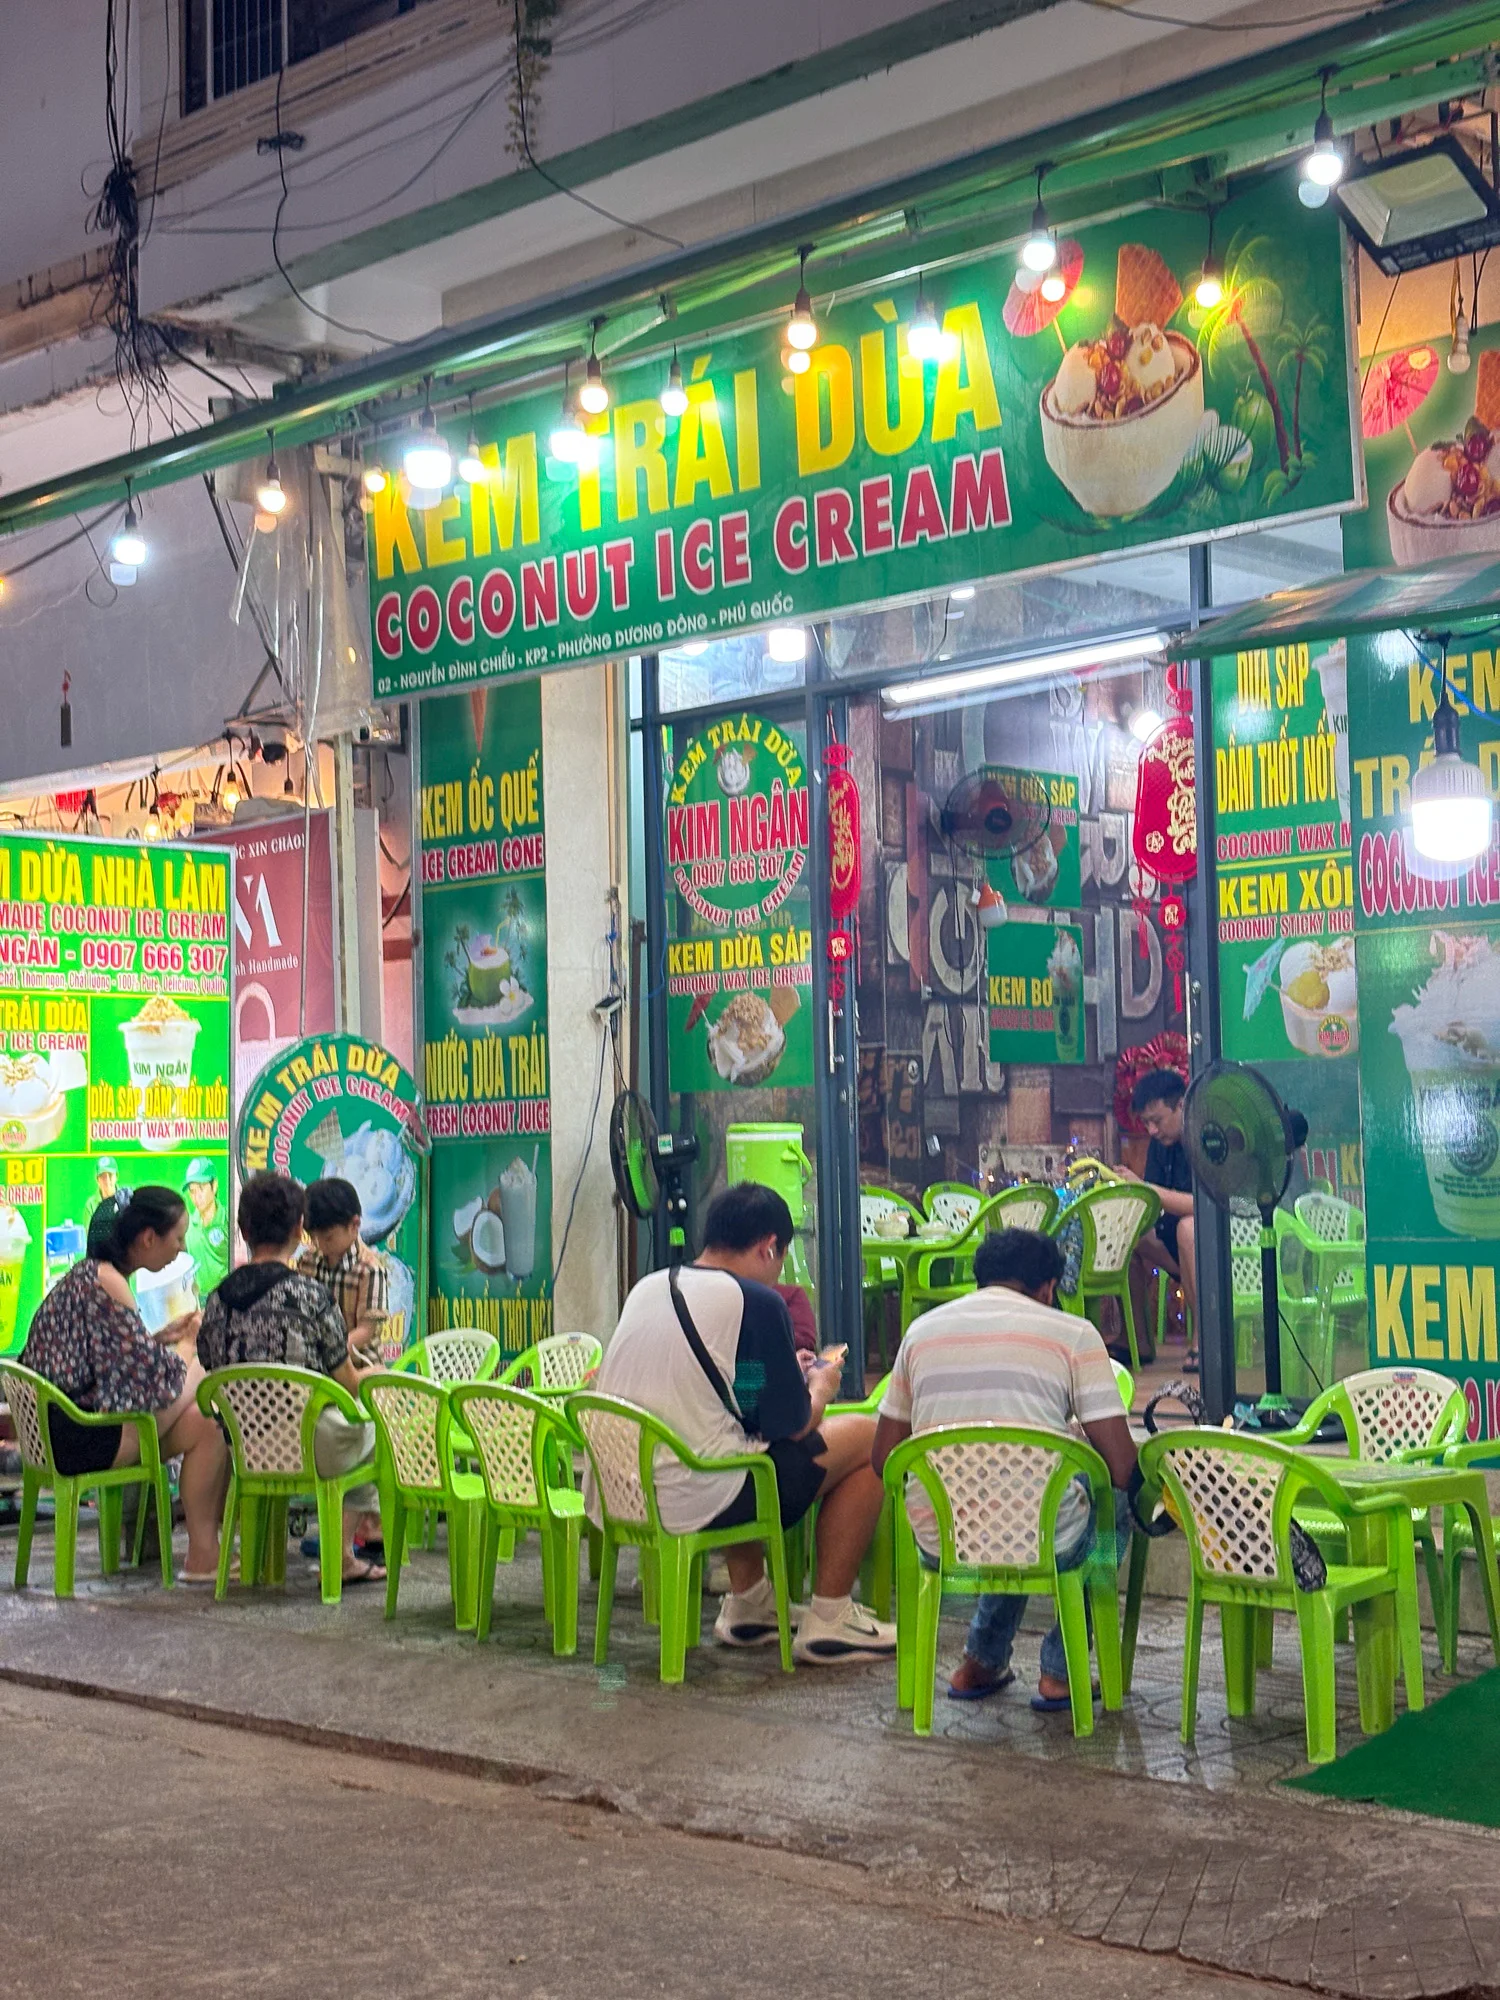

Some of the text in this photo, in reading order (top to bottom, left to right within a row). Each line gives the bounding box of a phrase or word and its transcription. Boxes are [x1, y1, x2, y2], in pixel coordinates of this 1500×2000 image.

[373, 431, 541, 582] KEM
[576, 355, 762, 532] TRÁI
[374, 446, 1014, 662] COCONUT ICE CREAM
[377, 675, 392, 694] 02
[448, 659, 478, 680] ĐÌNH
[525, 646, 549, 667] KP2
[557, 632, 612, 660] PHƯỜNG
[615, 621, 664, 647] DƯƠNG
[666, 612, 709, 637] ĐÔNG
[718, 600, 747, 628] PHÚ
[750, 590, 795, 621] QUỐC
[671, 741, 707, 806] KEM
[707, 712, 762, 750] TRÁI
[1258, 713, 1299, 809] THỐT
[1303, 707, 1337, 802] NỐT
[422, 748, 539, 841] KEM ỐC QUẾ
[1050, 777, 1077, 809] SÁP
[667, 801, 721, 867] KIM
[728, 777, 810, 858] NGÂN
[1216, 826, 1293, 861] COCONUT
[1297, 821, 1335, 851] WAX
[248, 839, 268, 859] XIN
[420, 832, 545, 884] ICE CREAM CONE
[20, 840, 84, 905] DỪA
[93, 847, 156, 909] NHÀ
[164, 851, 226, 913] LÀM
[673, 850, 807, 928] COCONUT ICE CREAM
[691, 852, 786, 889] 0907 666 307
[1219, 857, 1354, 918] KEM XÔI
[51, 905, 131, 936] COCONUT
[136, 909, 164, 939] ICE
[168, 911, 227, 941] CREAM
[1218, 916, 1278, 943] COCONUT
[1280, 911, 1325, 939] STICKY
[81, 938, 138, 970] 0907
[143, 941, 183, 972] 666
[189, 944, 229, 975] 307
[249, 953, 298, 975] Handmade
[668, 924, 812, 975] KEM DỪA SÁP
[668, 972, 720, 997] COCONUT
[722, 968, 750, 993] WAX
[750, 967, 770, 991] ICE
[989, 976, 1026, 1007] KEM
[45, 996, 88, 1032] DỪA
[11, 1032, 35, 1051] ICE
[38, 1032, 88, 1051] CREAM
[425, 1020, 547, 1102] NƯỚC DỪA TRÁI
[133, 1061, 152, 1076] KIM
[91, 1079, 115, 1119] DỪA
[245, 1041, 401, 1171] KEM TRÁI DỪA
[426, 1097, 550, 1138] FRESH COCONUT JUICE
[91, 1120, 229, 1140] COCONUT WAX MIX PALM
[272, 1074, 411, 1179] COCONUT ICE CREAM
[7, 1156, 44, 1185] BƠ
[1373, 1264, 1498, 1363] KEM
